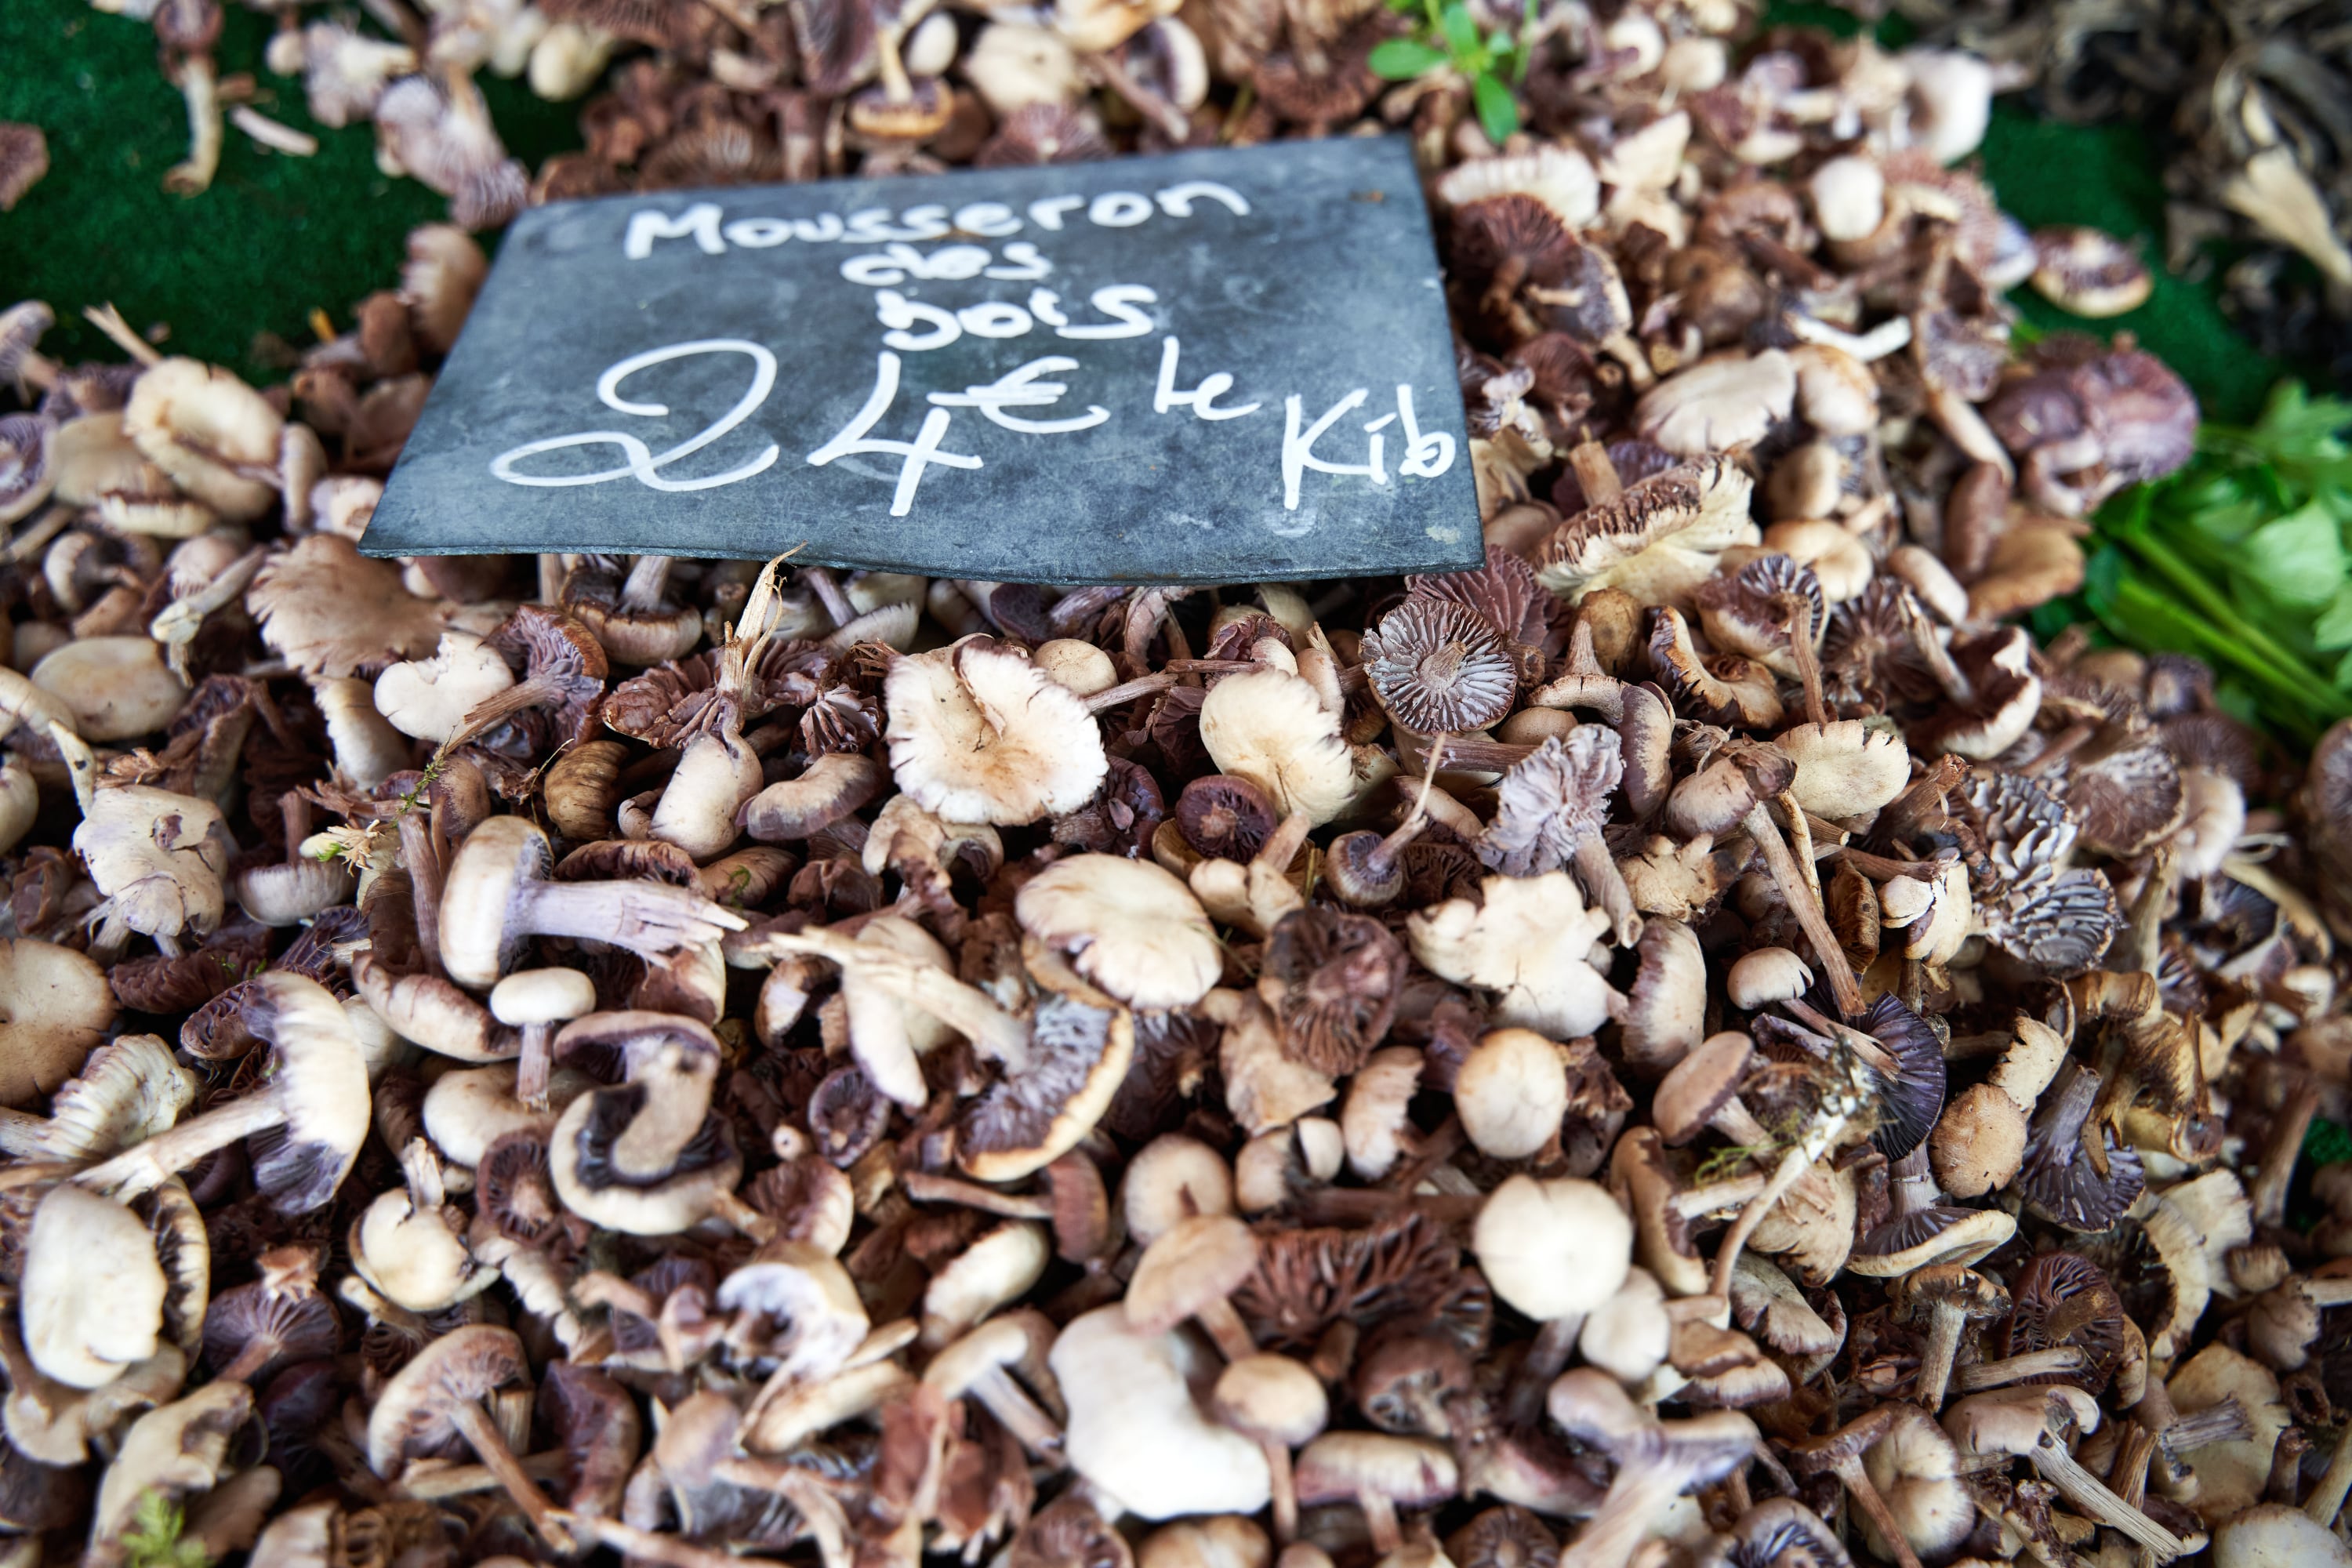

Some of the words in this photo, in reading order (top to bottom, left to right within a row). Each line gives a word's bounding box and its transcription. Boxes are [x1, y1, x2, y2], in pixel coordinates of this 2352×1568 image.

[625, 180, 1251, 260] Mousseron
[840, 241, 1053, 286] des
[876, 284, 1158, 351] bois
[1153, 336, 1262, 421] le
